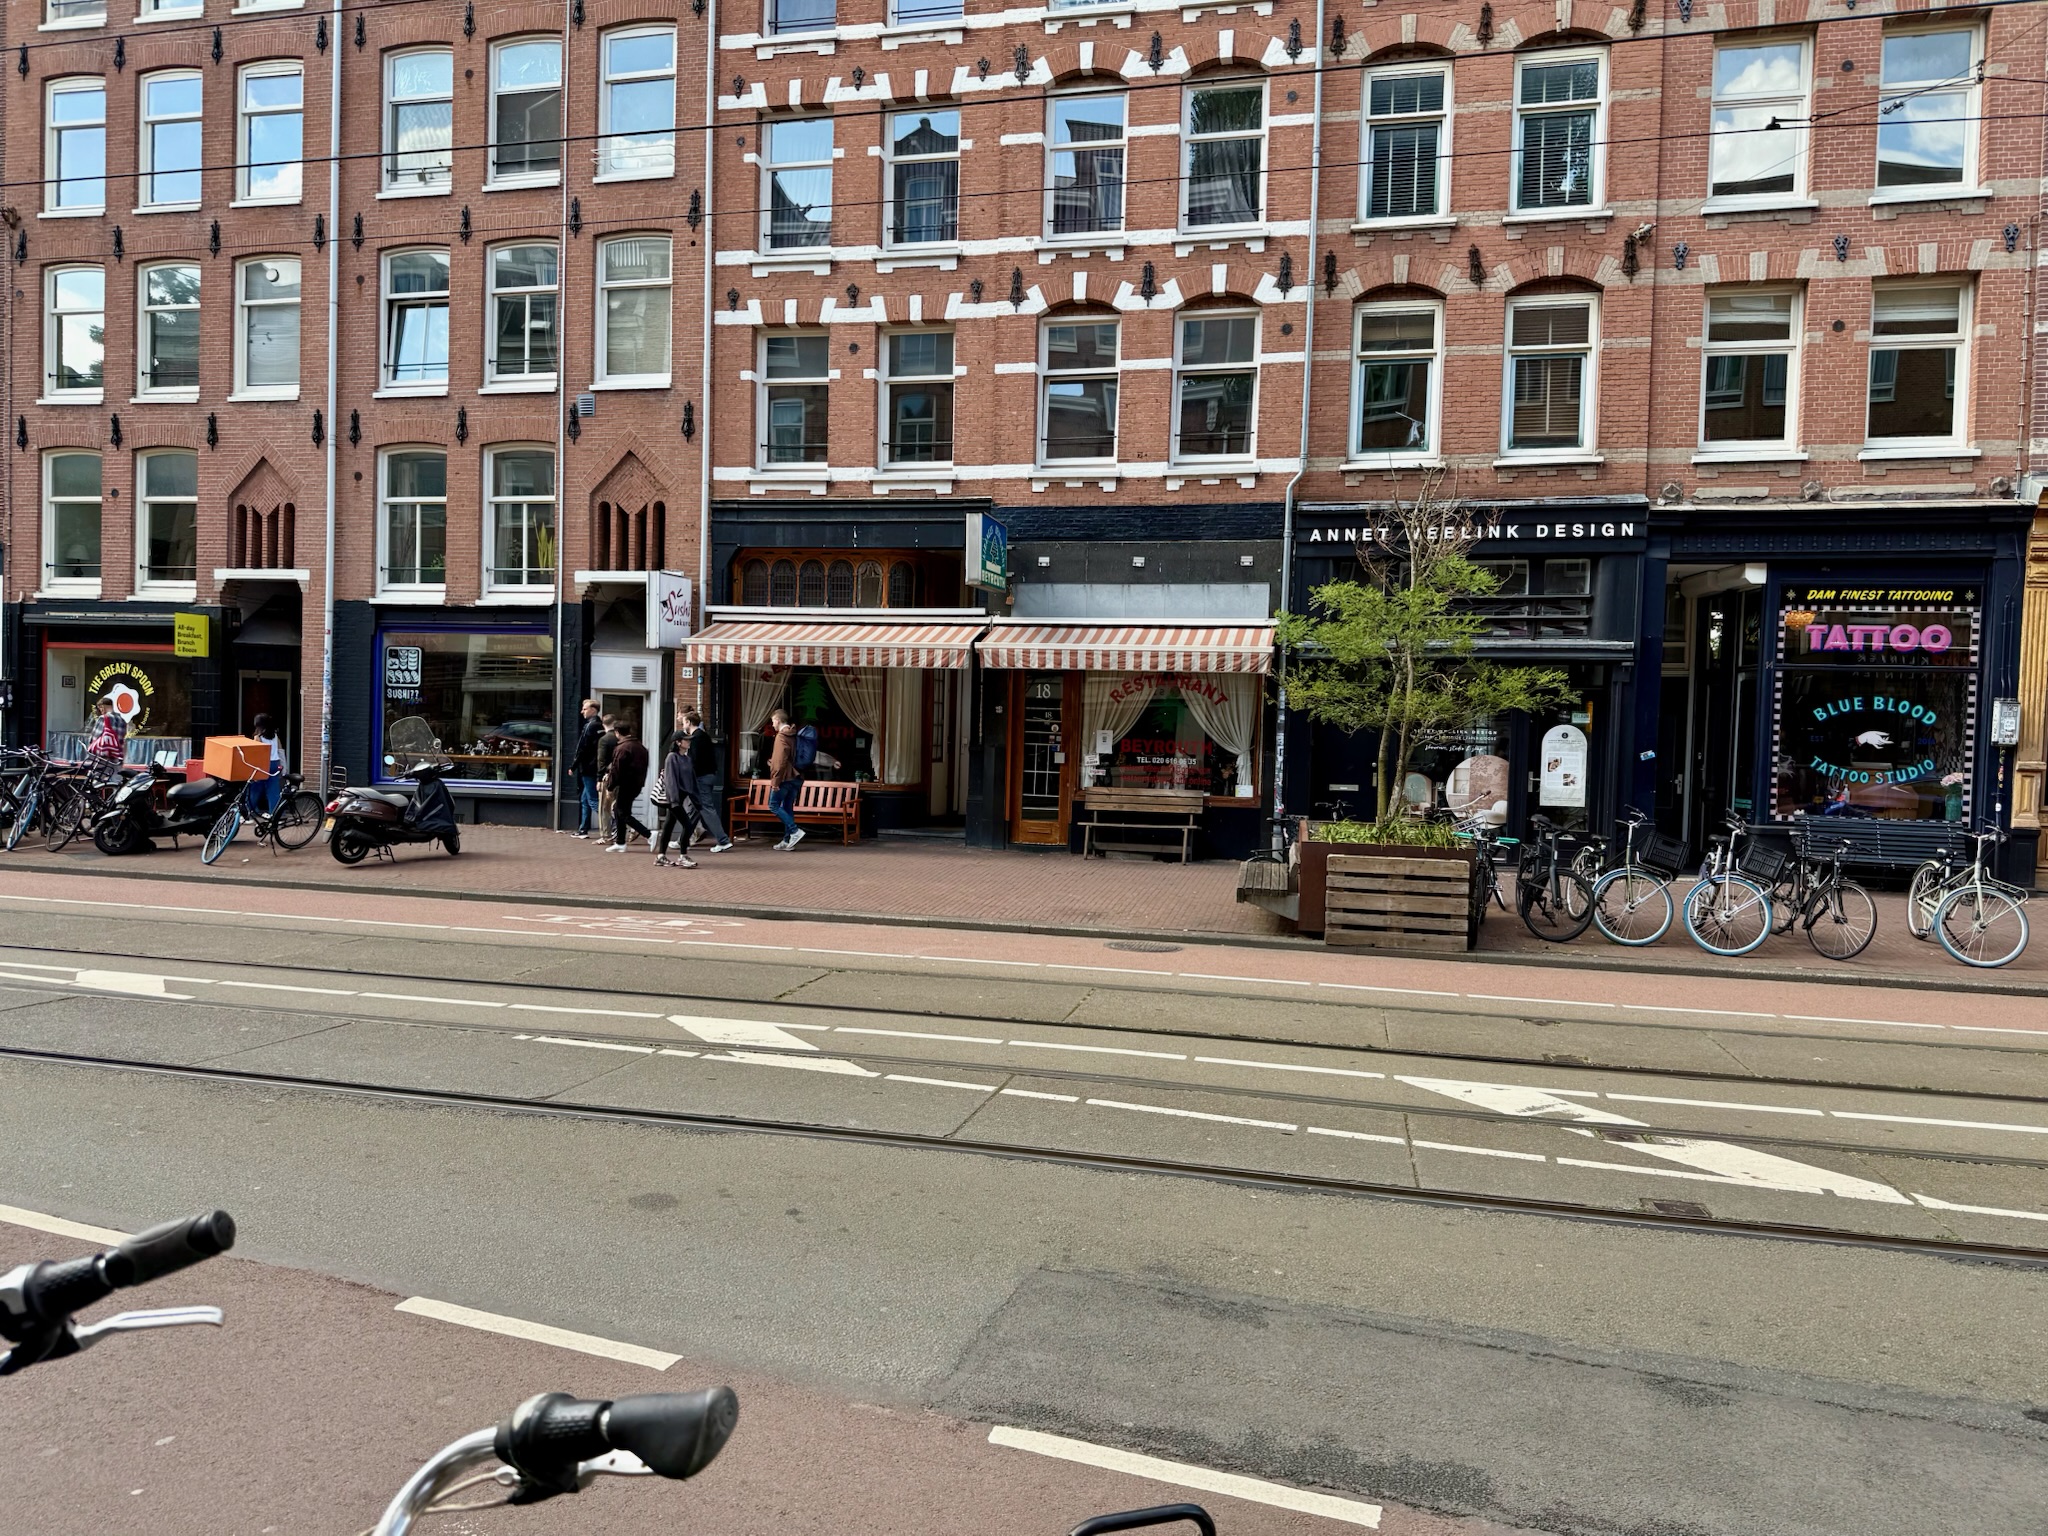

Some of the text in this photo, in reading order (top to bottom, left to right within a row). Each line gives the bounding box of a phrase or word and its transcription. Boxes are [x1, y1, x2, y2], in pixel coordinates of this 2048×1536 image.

[1309, 527, 1390, 542] ANNET
[1536, 522, 1634, 538] DESIGN
[1806, 589, 1955, 602] DAM FINEST TATTOOING
[664, 590, 691, 622] Sushi
[177, 624, 195, 632] All-day
[1805, 624, 1953, 654] TATTOO
[88, 662, 154, 696] THE GREASY SPOON
[683, 669, 692, 677] 22
[387, 688, 419, 699] SUSHI??
[1035, 683, 1051, 699] 18
[1109, 672, 1229, 706] RESTAURANT
[1812, 696, 1937, 725] BLUE BLOOD
[1119, 737, 1212, 757] BEYROUTH
[1136, 756, 1151, 764] TEL.
[1808, 755, 1935, 784] TATTOO STUDIO
